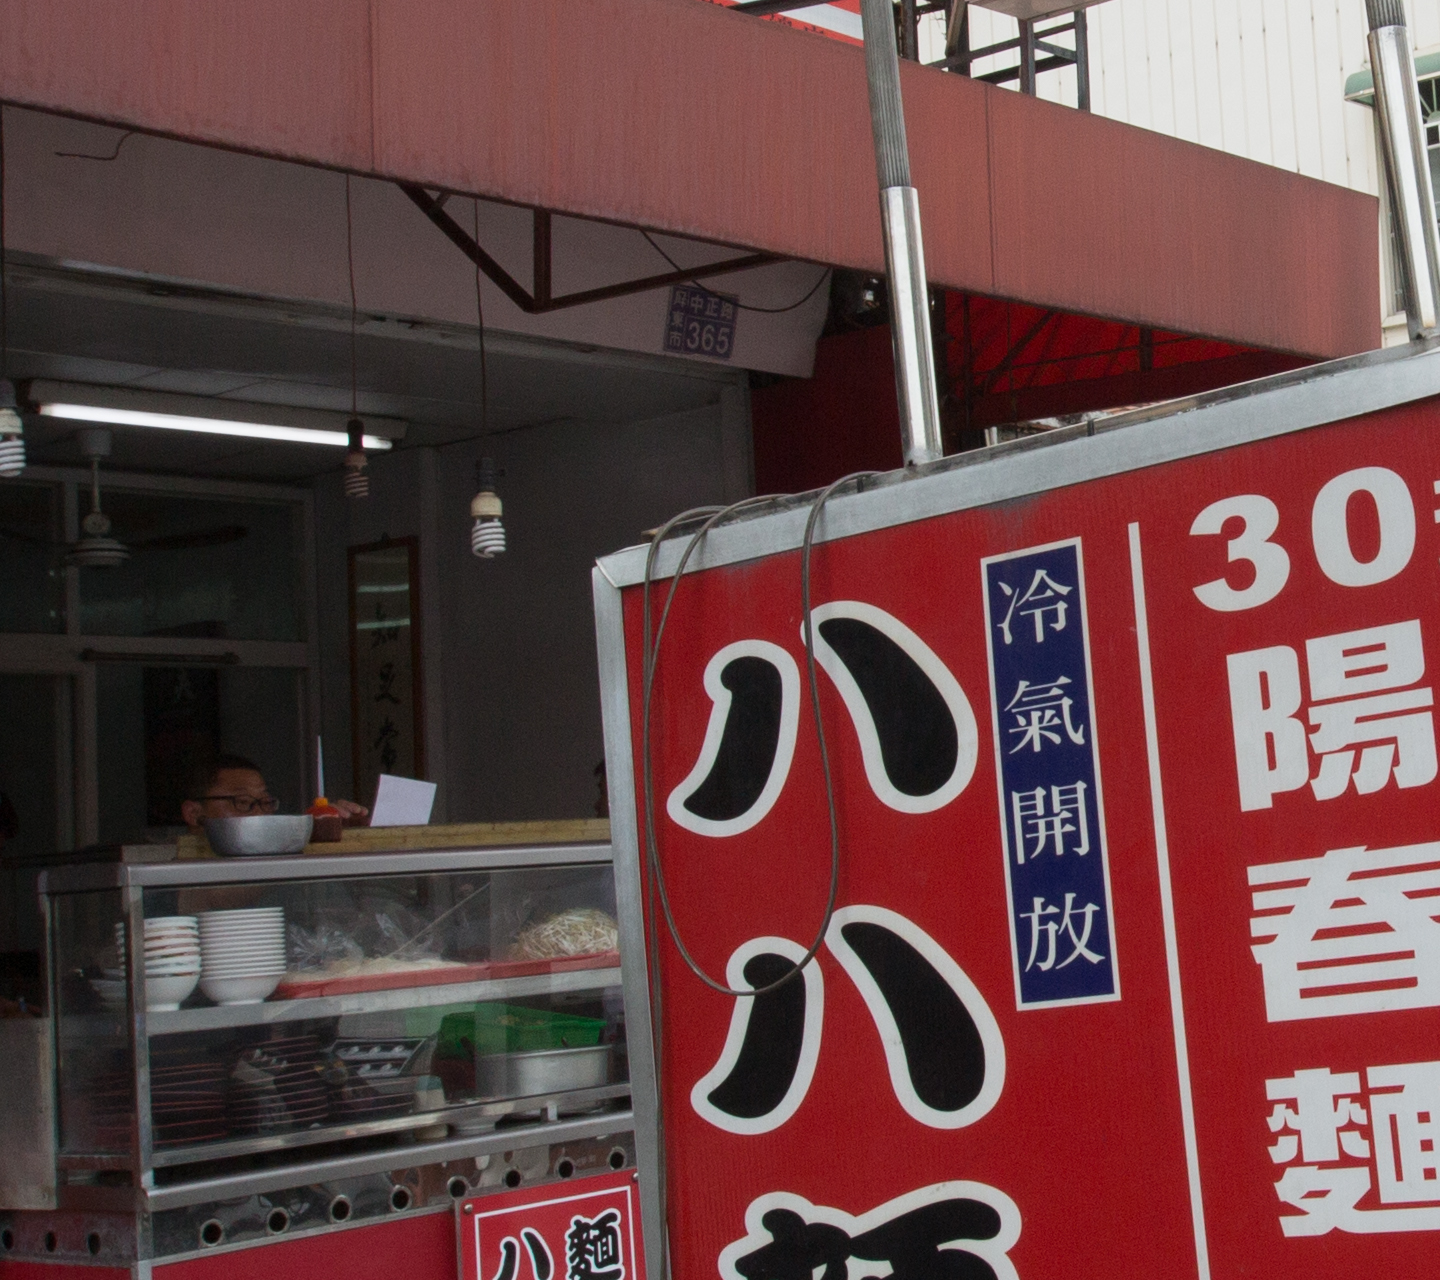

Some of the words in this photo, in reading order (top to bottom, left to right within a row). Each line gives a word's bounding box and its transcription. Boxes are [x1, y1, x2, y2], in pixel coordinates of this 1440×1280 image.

[686, 321, 732, 355] 365
[995, 571, 1108, 978] 冷氣開放
